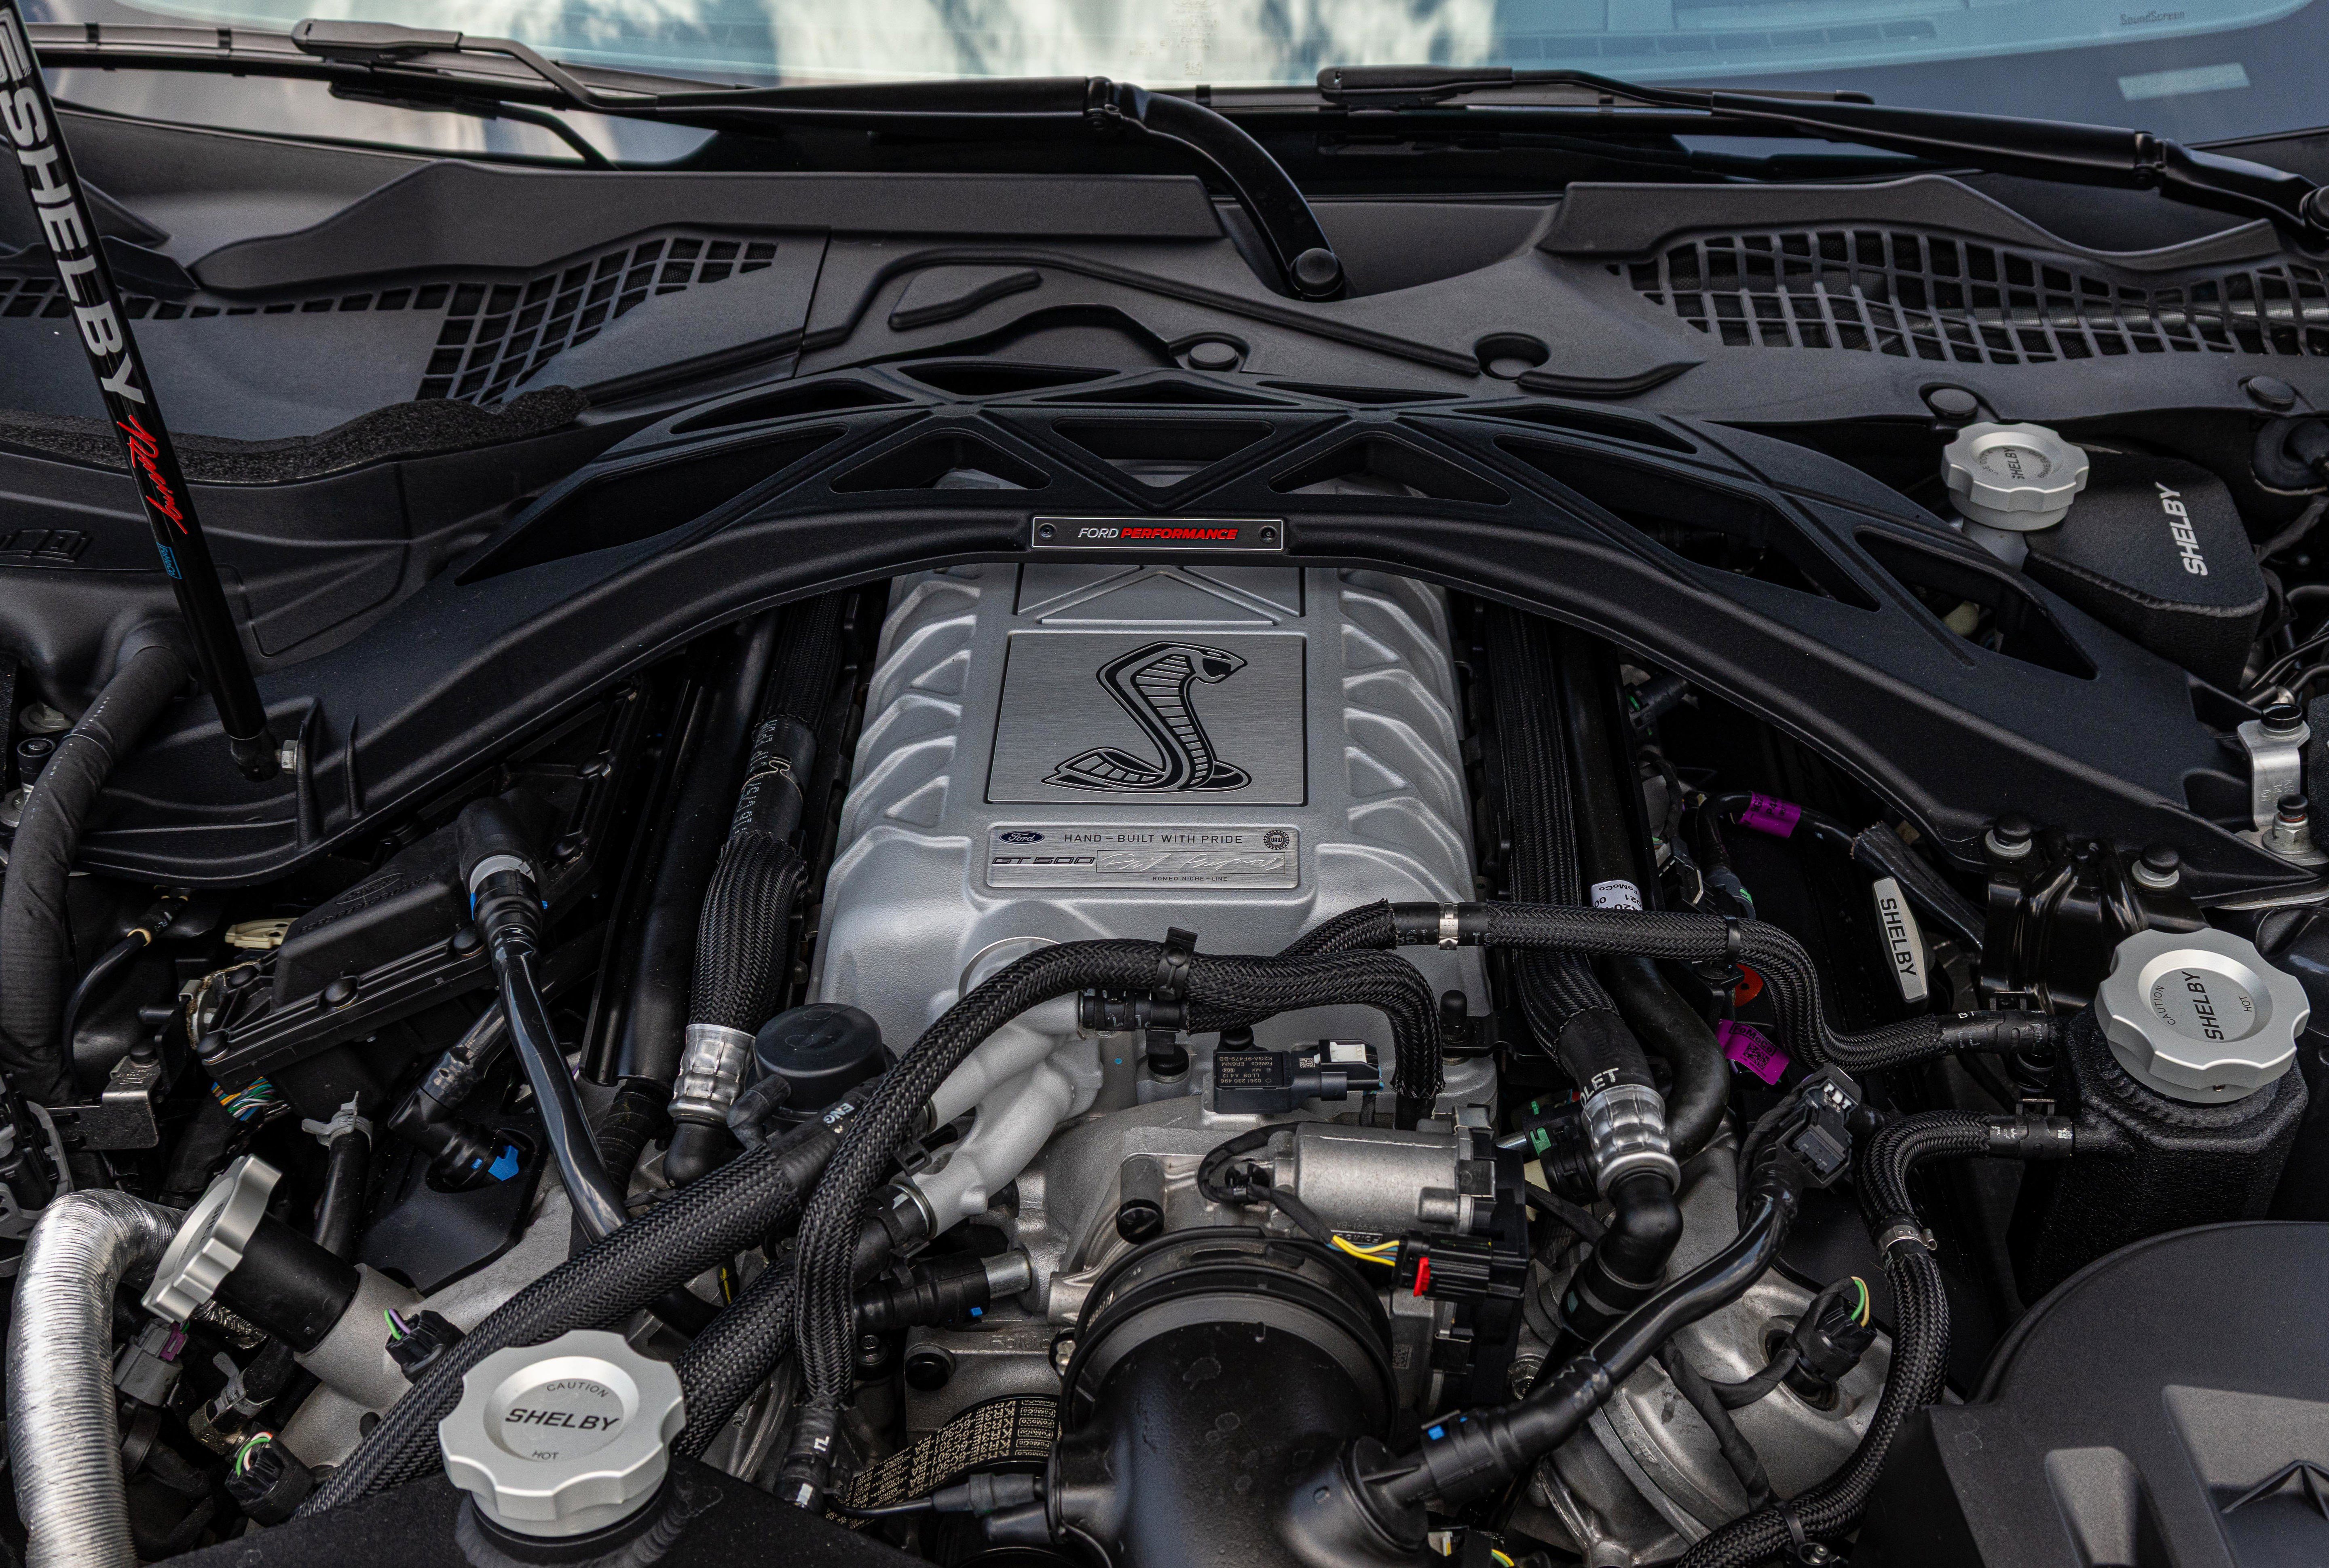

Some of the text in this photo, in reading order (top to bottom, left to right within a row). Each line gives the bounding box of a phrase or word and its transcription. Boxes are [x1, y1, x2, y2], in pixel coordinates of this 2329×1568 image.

[2120, 10, 2185, 25] SoundScreen
[0, 87, 188, 535] SHELBY Racing
[1078, 527, 1238, 539] FORD PERFORMANCE
[2155, 481, 2208, 576] SHELBY
[159, 547, 175, 577] FoMoCo
[1008, 832, 1036, 842] Ford
[1064, 834, 1101, 842] HAND
[1118, 835, 1154, 843] BUILT
[1161, 835, 1195, 843] WITH
[1201, 835, 1243, 844] PRIDE
[1599, 884, 1638, 895] FoMoCo
[1879, 898, 1916, 976] SHELBY
[2153, 985, 2176, 1026] CAUTION
[2181, 970, 2225, 1041] SHELBY
[2238, 995, 2252, 1012] HOT
[1733, 1025, 1773, 1053] FoMoCo
[547, 1381, 609, 1398] CAUTION
[505, 1408, 620, 1431] SHELBY
[531, 1450, 559, 1460] HOT
